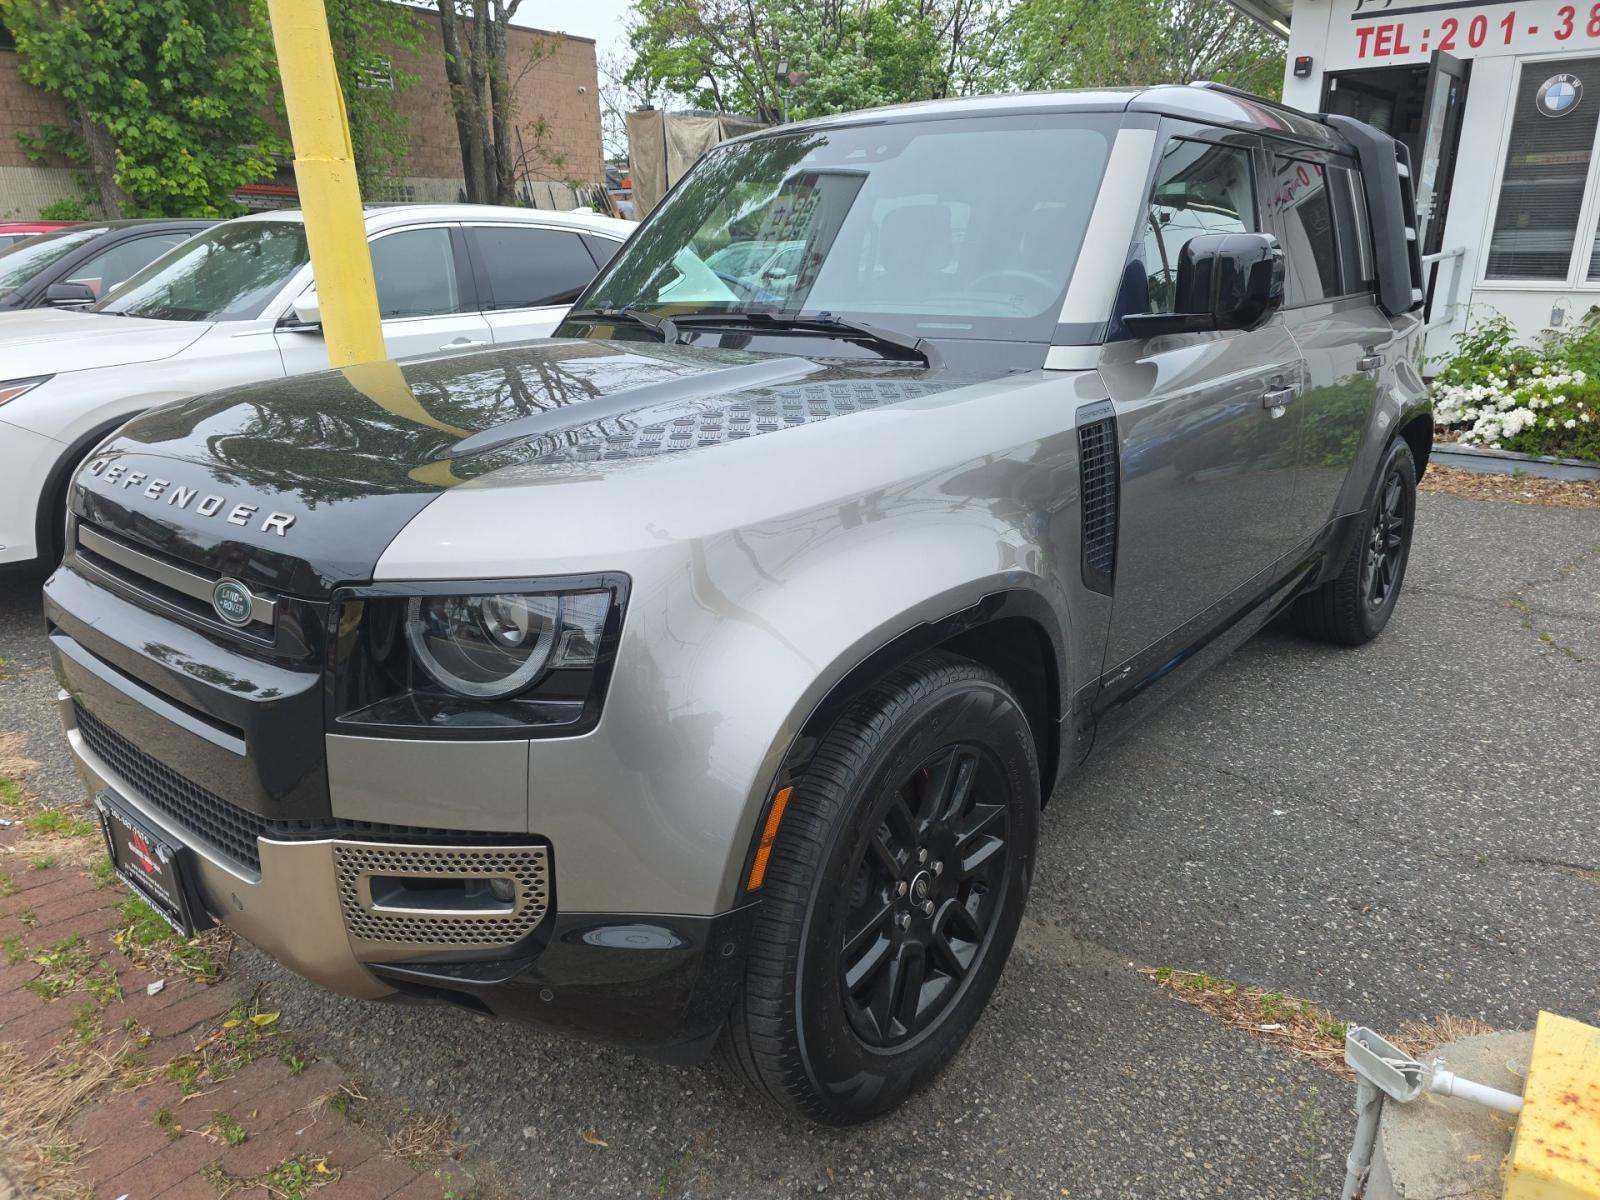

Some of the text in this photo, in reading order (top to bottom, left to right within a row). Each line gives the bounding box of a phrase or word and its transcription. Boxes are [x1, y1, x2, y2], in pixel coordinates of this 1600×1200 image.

[91, 459, 297, 537] DEFENDER
[222, 588, 240, 602] LAND
[223, 599, 244, 615] ROVER
